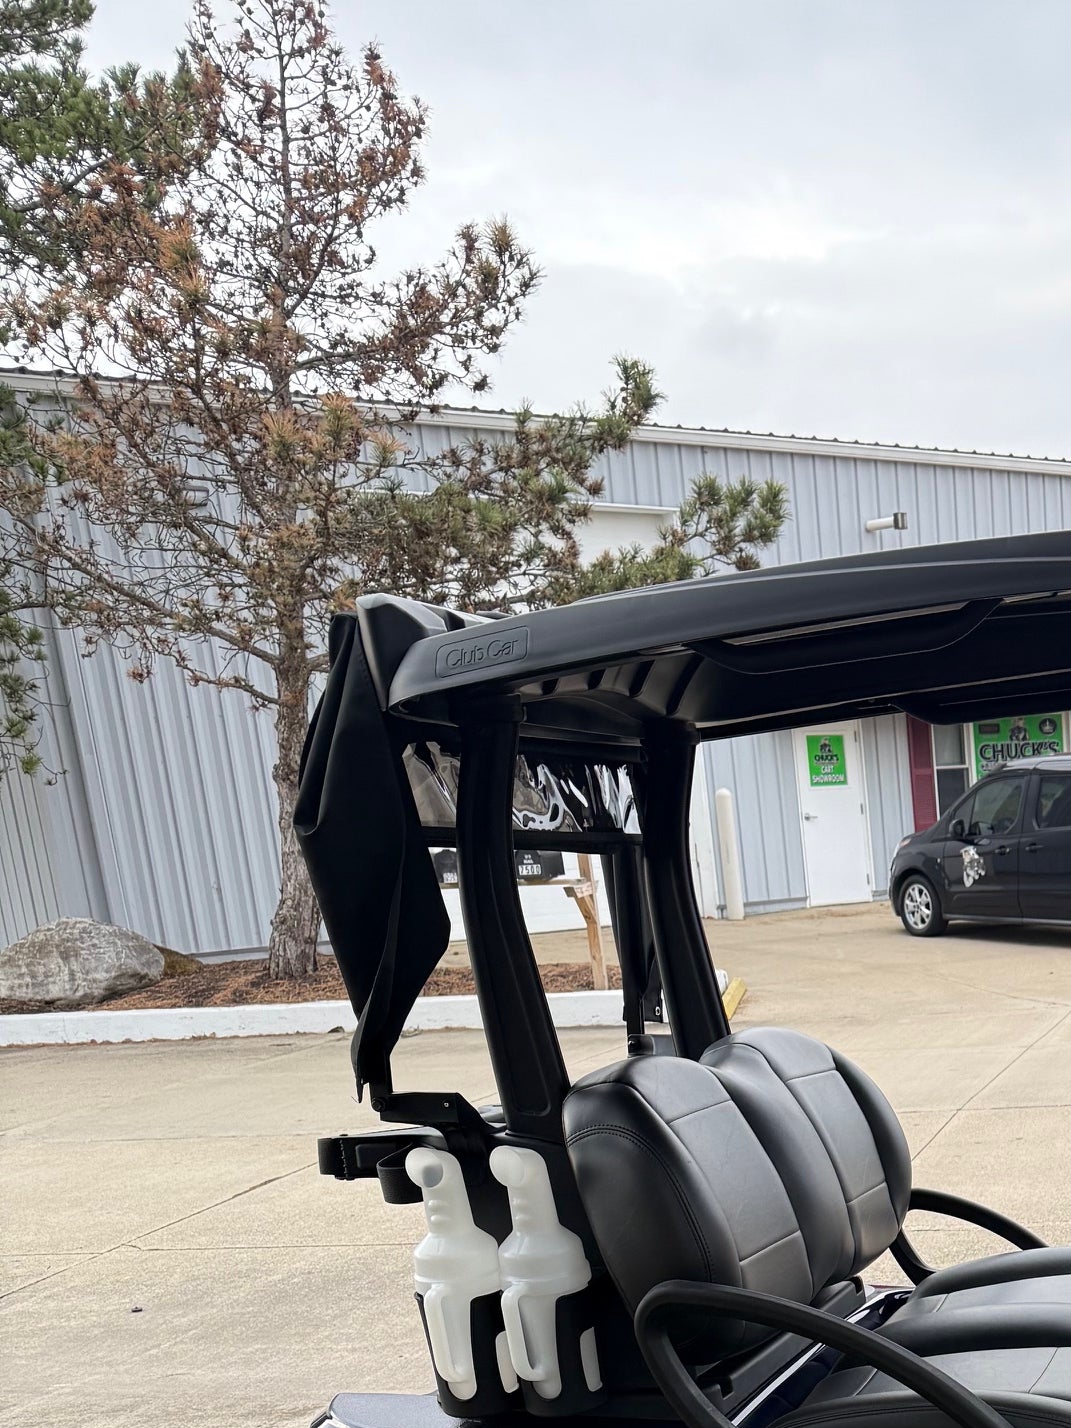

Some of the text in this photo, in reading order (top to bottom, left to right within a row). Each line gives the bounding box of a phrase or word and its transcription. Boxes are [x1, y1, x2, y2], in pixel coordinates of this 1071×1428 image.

[446, 639, 519, 667] Club Car
[979, 740, 1060, 761] CHUCK'S
